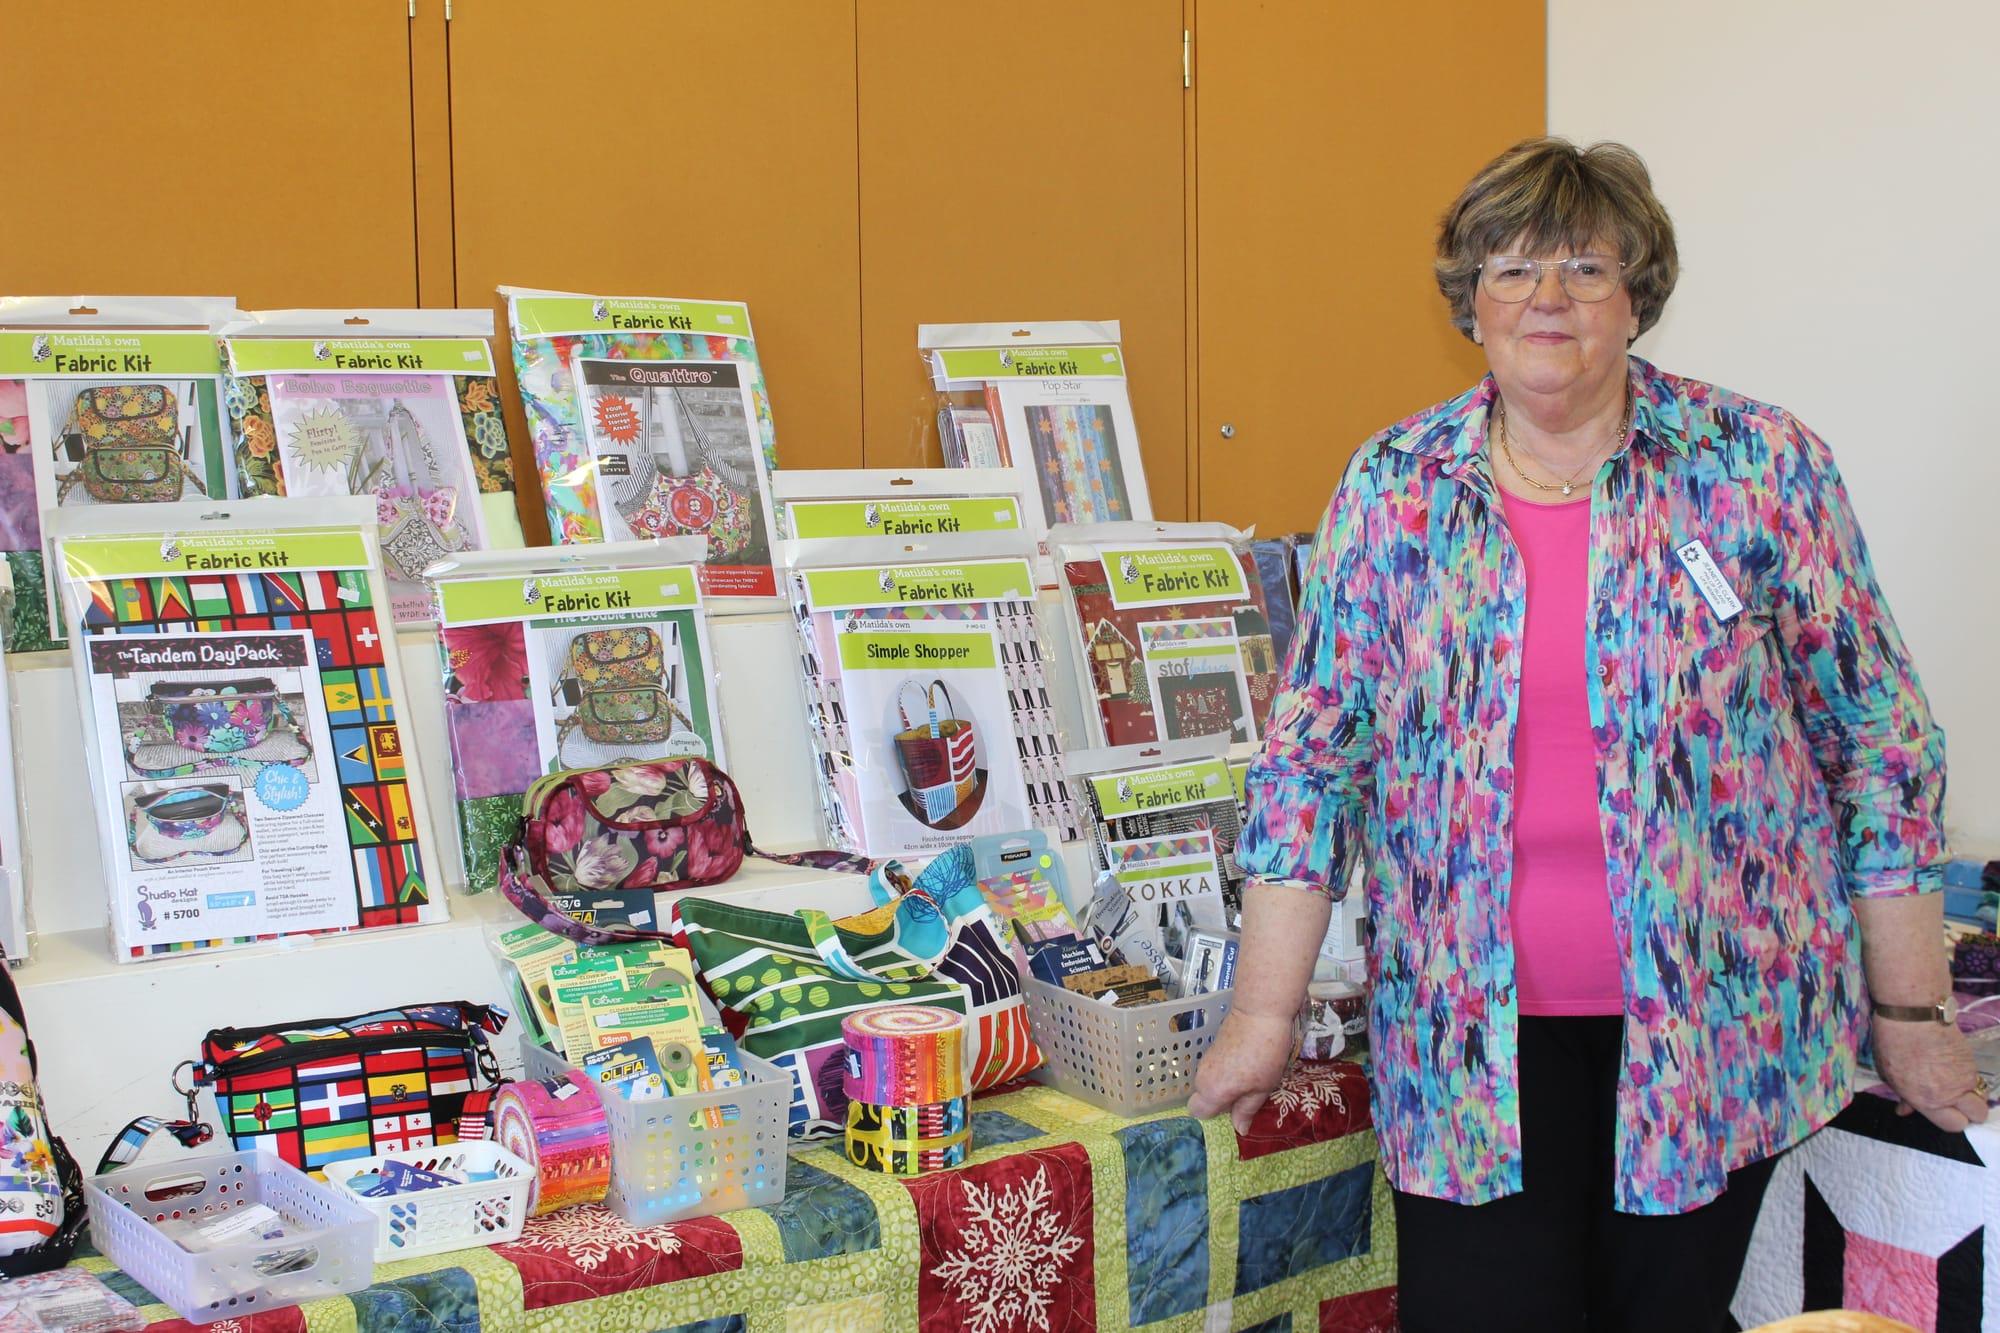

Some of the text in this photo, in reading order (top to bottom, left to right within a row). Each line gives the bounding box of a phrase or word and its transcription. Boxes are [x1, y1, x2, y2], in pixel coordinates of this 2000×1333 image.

[659, 302, 681, 311] own
[612, 315, 692, 330] Fabric Kit
[52, 335, 141, 347] Matilda's own
[331, 341, 384, 349] Matilda's
[55, 354, 152, 372] Fabric Kit
[335, 354, 423, 369] Fabric Kit
[1016, 361, 1078, 376] Fabric Kit
[629, 367, 712, 384] Quattro
[284, 379, 432, 396] Boho Baguette
[1042, 380, 1083, 395] Pop Star
[307, 424, 338, 439] Flirty!
[880, 502, 950, 513] Matilda's own
[883, 518, 961, 535] Fabric Kit
[182, 537, 275, 548] Matilda's own
[185, 551, 289, 570] Fabric Kit
[1135, 552, 1214, 566] Matilda's own
[894, 568, 963, 578] Matilda's own
[1143, 568, 1230, 593] Fabric Kit
[541, 575, 593, 588] Matilda's
[595, 575, 620, 585] own
[898, 582, 974, 601] Fabric Kit
[544, 590, 631, 612] Fabric Kit
[580, 612, 626, 622] Double
[860, 620, 893, 629] Matilda's
[117, 643, 279, 665] The Tandem DayPack
[867, 643, 970, 660] Simple Shopper
[1159, 657, 1190, 676] stof
[265, 770, 288, 784] Chic
[263, 784, 302, 804] Stylish!
[1136, 788, 1181, 809] Fabric
[1185, 783, 1207, 800] Kit
[137, 885, 198, 903] Studio Kat
[164, 908, 200, 920] # 5700
[580, 948, 609, 960] Clover
[1062, 950, 1085, 960] Machine
[1061, 957, 1092, 968] Embroidery
[1069, 965, 1091, 975] Scissors
[554, 967, 578, 976] Clover
[592, 994, 623, 1006] Clover
[602, 1035, 628, 1045] 28mm
[601, 1061, 643, 1081] OLFA
